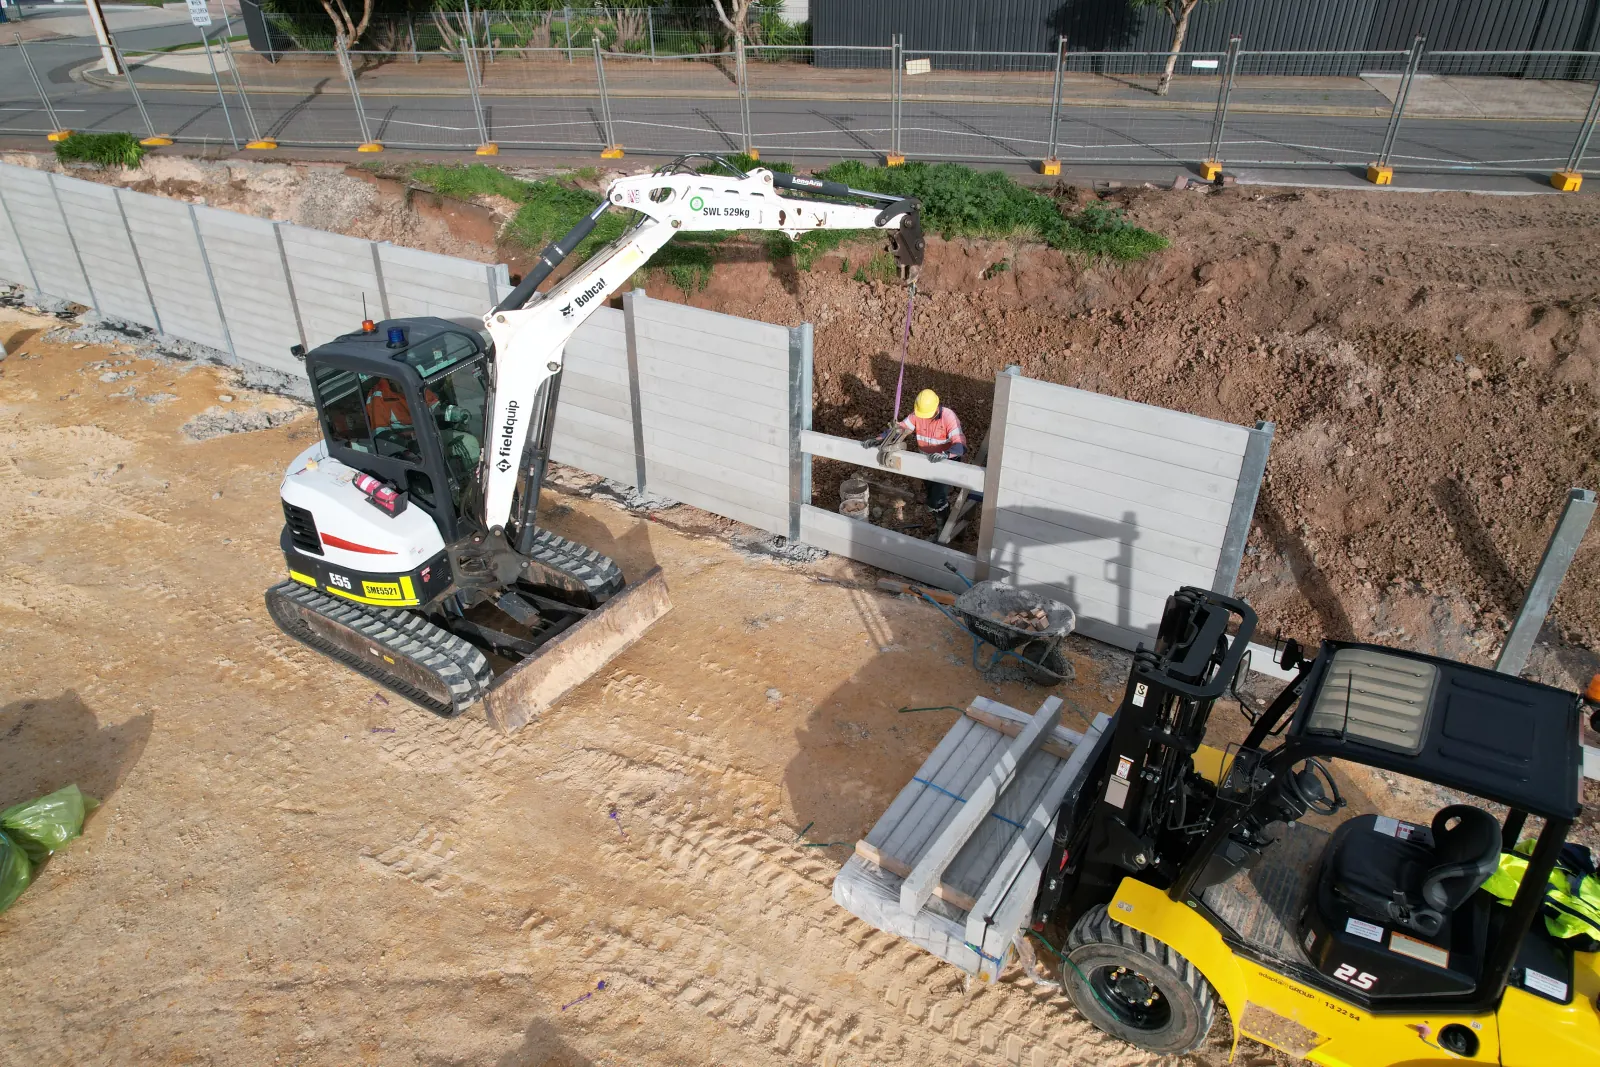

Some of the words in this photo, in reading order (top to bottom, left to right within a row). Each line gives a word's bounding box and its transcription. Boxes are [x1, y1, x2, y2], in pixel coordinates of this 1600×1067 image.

[703, 207, 721, 216] SWL
[723, 207, 750, 218] 529kg
[574, 277, 608, 308] Bobcat
[499, 400, 520, 457] fieldquip
[328, 572, 352, 590] E55
[365, 585, 398, 596] SME5521
[1333, 962, 1379, 990] 25
[1288, 985, 1315, 999] GROUP
[1325, 1001, 1335, 1010] 13
[1336, 1007, 1348, 1016] 22
[1349, 1012, 1360, 1021] 54
